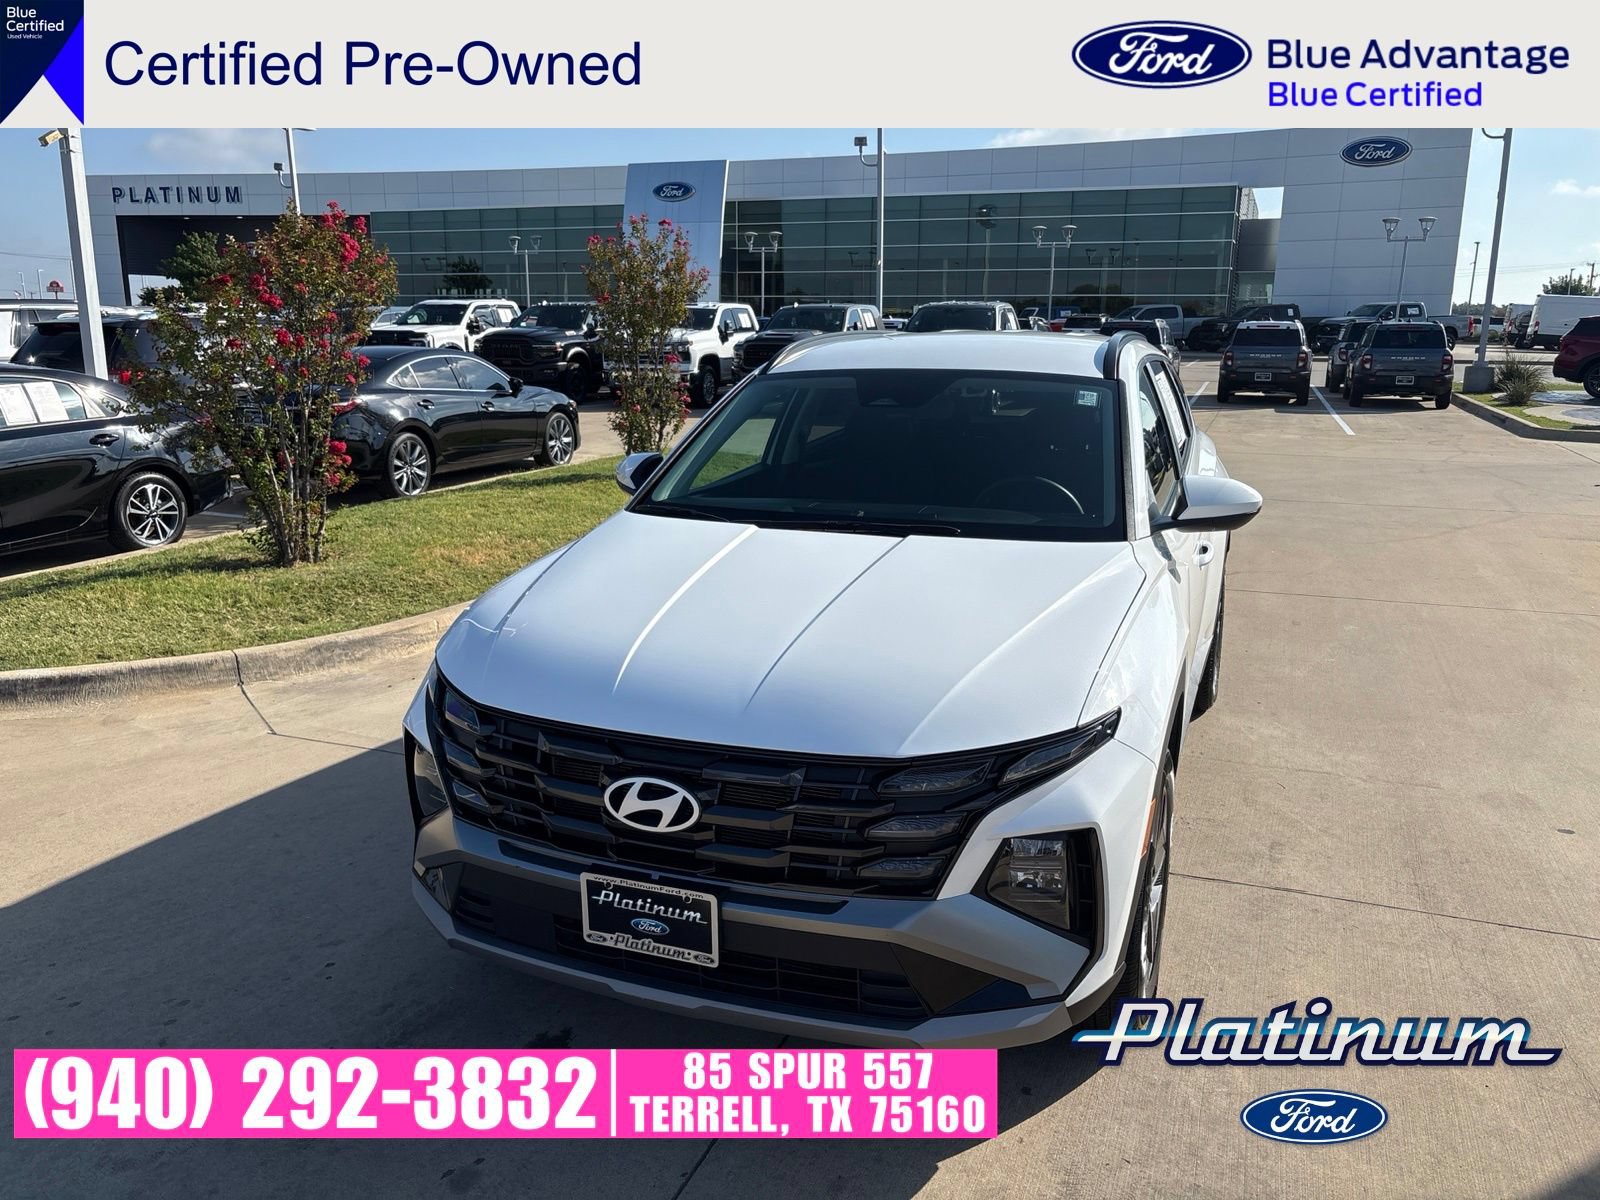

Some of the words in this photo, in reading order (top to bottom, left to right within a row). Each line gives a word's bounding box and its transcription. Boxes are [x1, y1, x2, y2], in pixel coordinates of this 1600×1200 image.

[1354, 143, 1396, 160] Ford
[111, 186, 243, 203] PLATINUM
[660, 185, 684, 197] Ford
[593, 875, 704, 899] www.PlatinumFord.com
[591, 889, 708, 925] Platinum
[638, 919, 662, 934] Ford
[614, 932, 692, 961] Platinum
